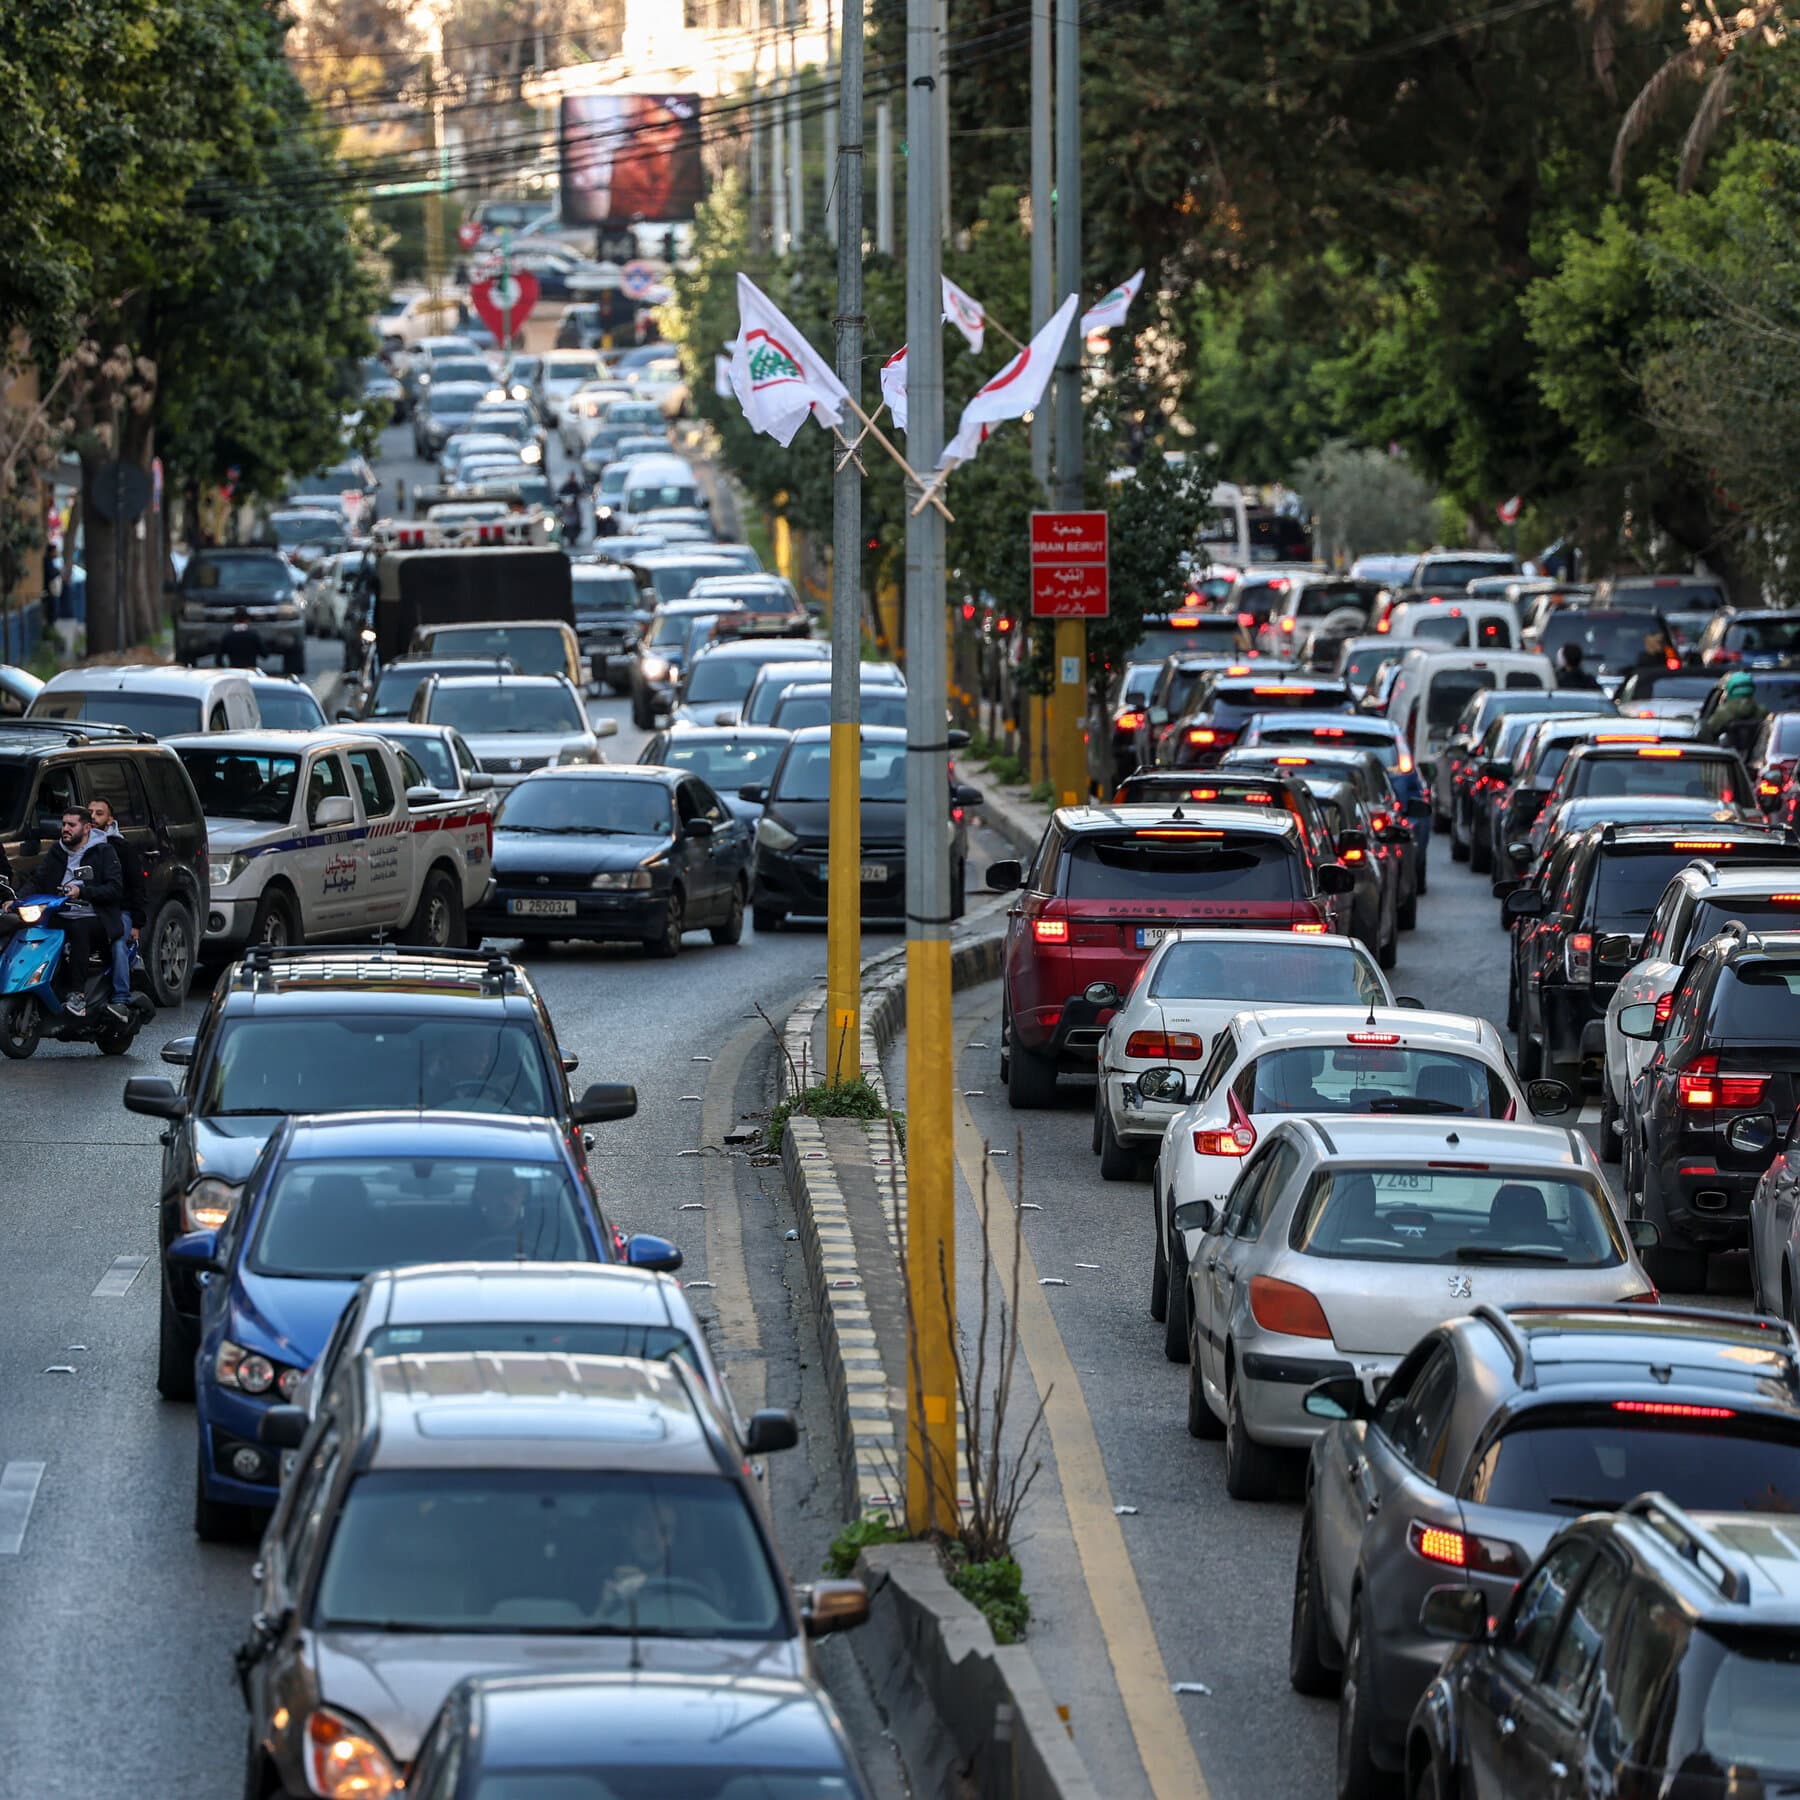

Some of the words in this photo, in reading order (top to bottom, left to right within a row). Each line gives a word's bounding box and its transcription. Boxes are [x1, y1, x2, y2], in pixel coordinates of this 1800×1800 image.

[1066, 541, 1104, 552] BEIRUT
[528, 901, 568, 912] 252034
[1191, 906, 1249, 914] ROVER
